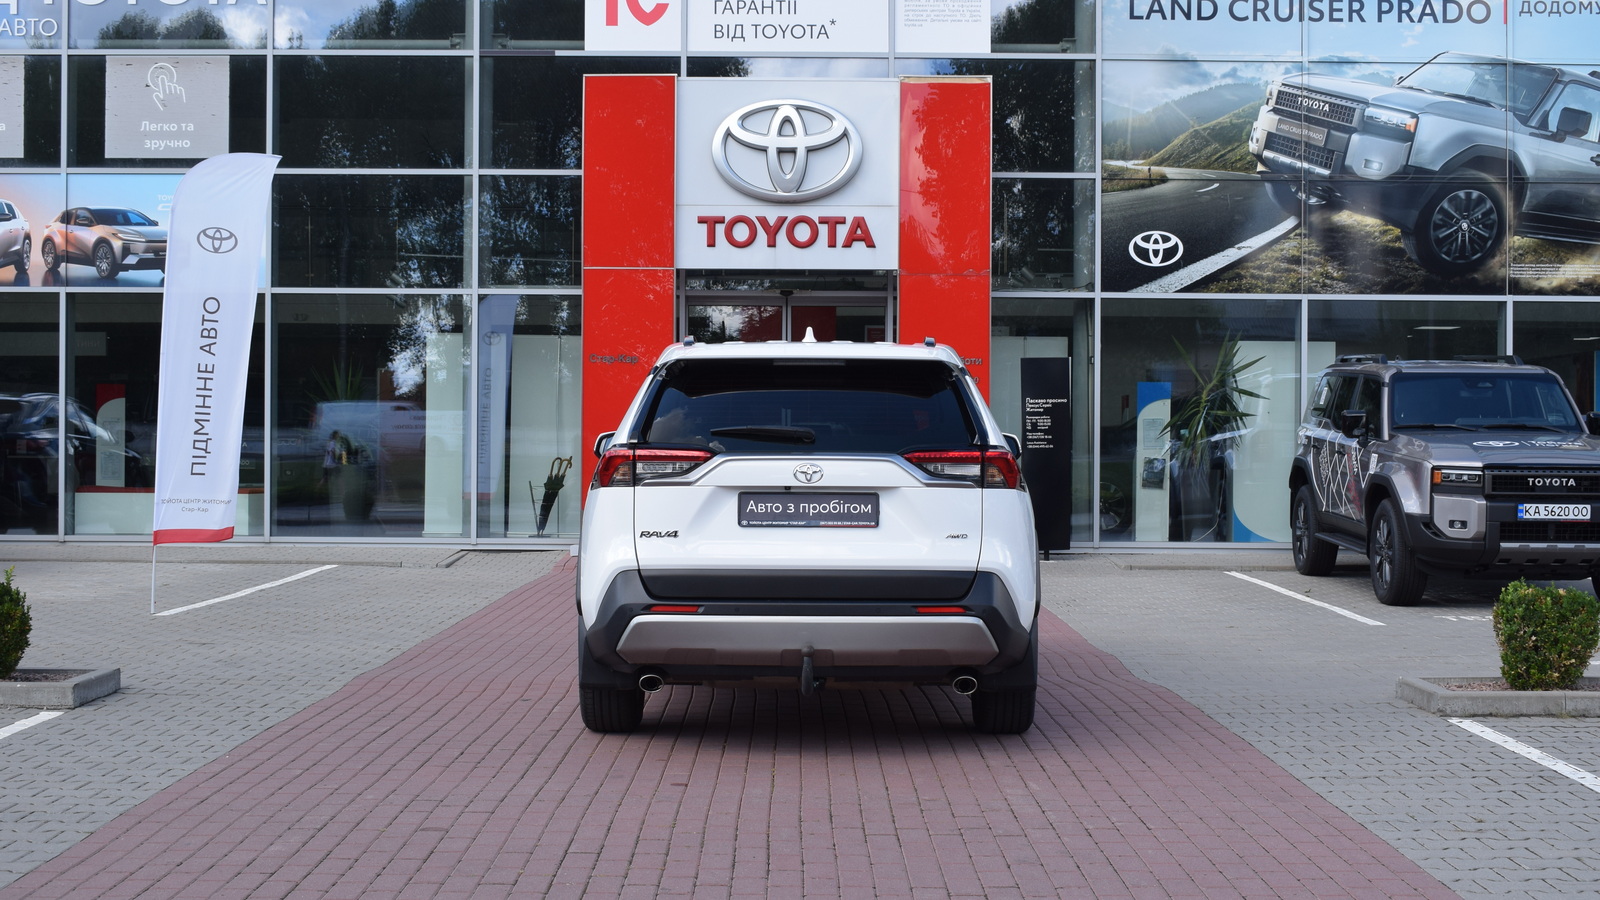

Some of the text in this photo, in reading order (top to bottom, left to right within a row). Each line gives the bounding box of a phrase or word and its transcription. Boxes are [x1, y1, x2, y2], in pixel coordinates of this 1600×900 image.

[1129, 0, 1491, 24] LAND CRUISER PRADO
[0, 18, 58, 37] АВТО
[714, 24, 746, 42] ВІД
[1297, 97, 1330, 112] TOYOTA
[140, 121, 194, 131] Легко та
[144, 140, 191, 150] зручно
[697, 215, 876, 248] TOYOTA
[589, 354, 639, 364] Стар-Кар
[190, 296, 221, 476] ПІДМІННЕ АВТО
[1527, 477, 1576, 487] TOYOTA
[746, 499, 872, 516] Авто з пробігом
[1524, 505, 1541, 517] KA
[1543, 505, 1570, 517] 5620
[639, 530, 680, 539] RAV4
